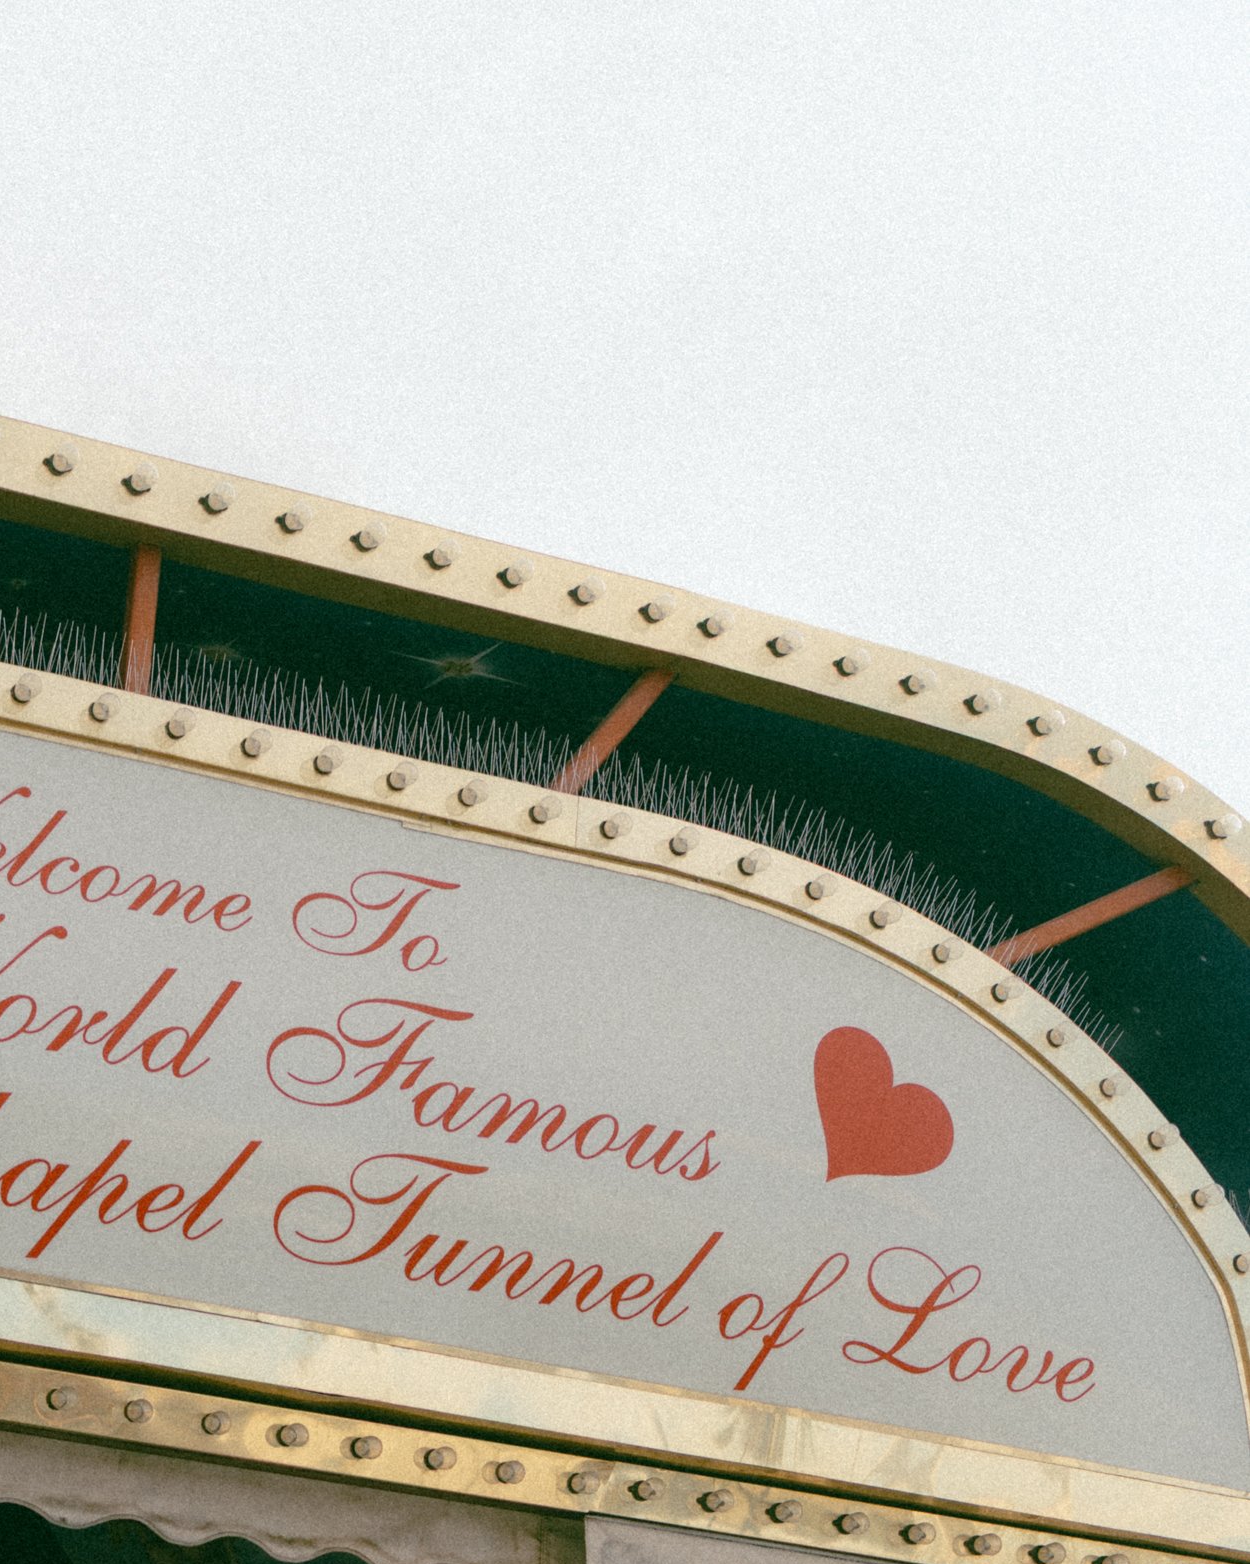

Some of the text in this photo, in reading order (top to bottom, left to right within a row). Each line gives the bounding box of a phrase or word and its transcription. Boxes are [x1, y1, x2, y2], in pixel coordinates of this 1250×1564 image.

[292, 871, 461, 971] To
[266, 998, 720, 1181] Famous
[273, 1153, 724, 1328] Tunnel
[718, 1252, 850, 1392] of
[842, 1246, 1096, 1403] Love
